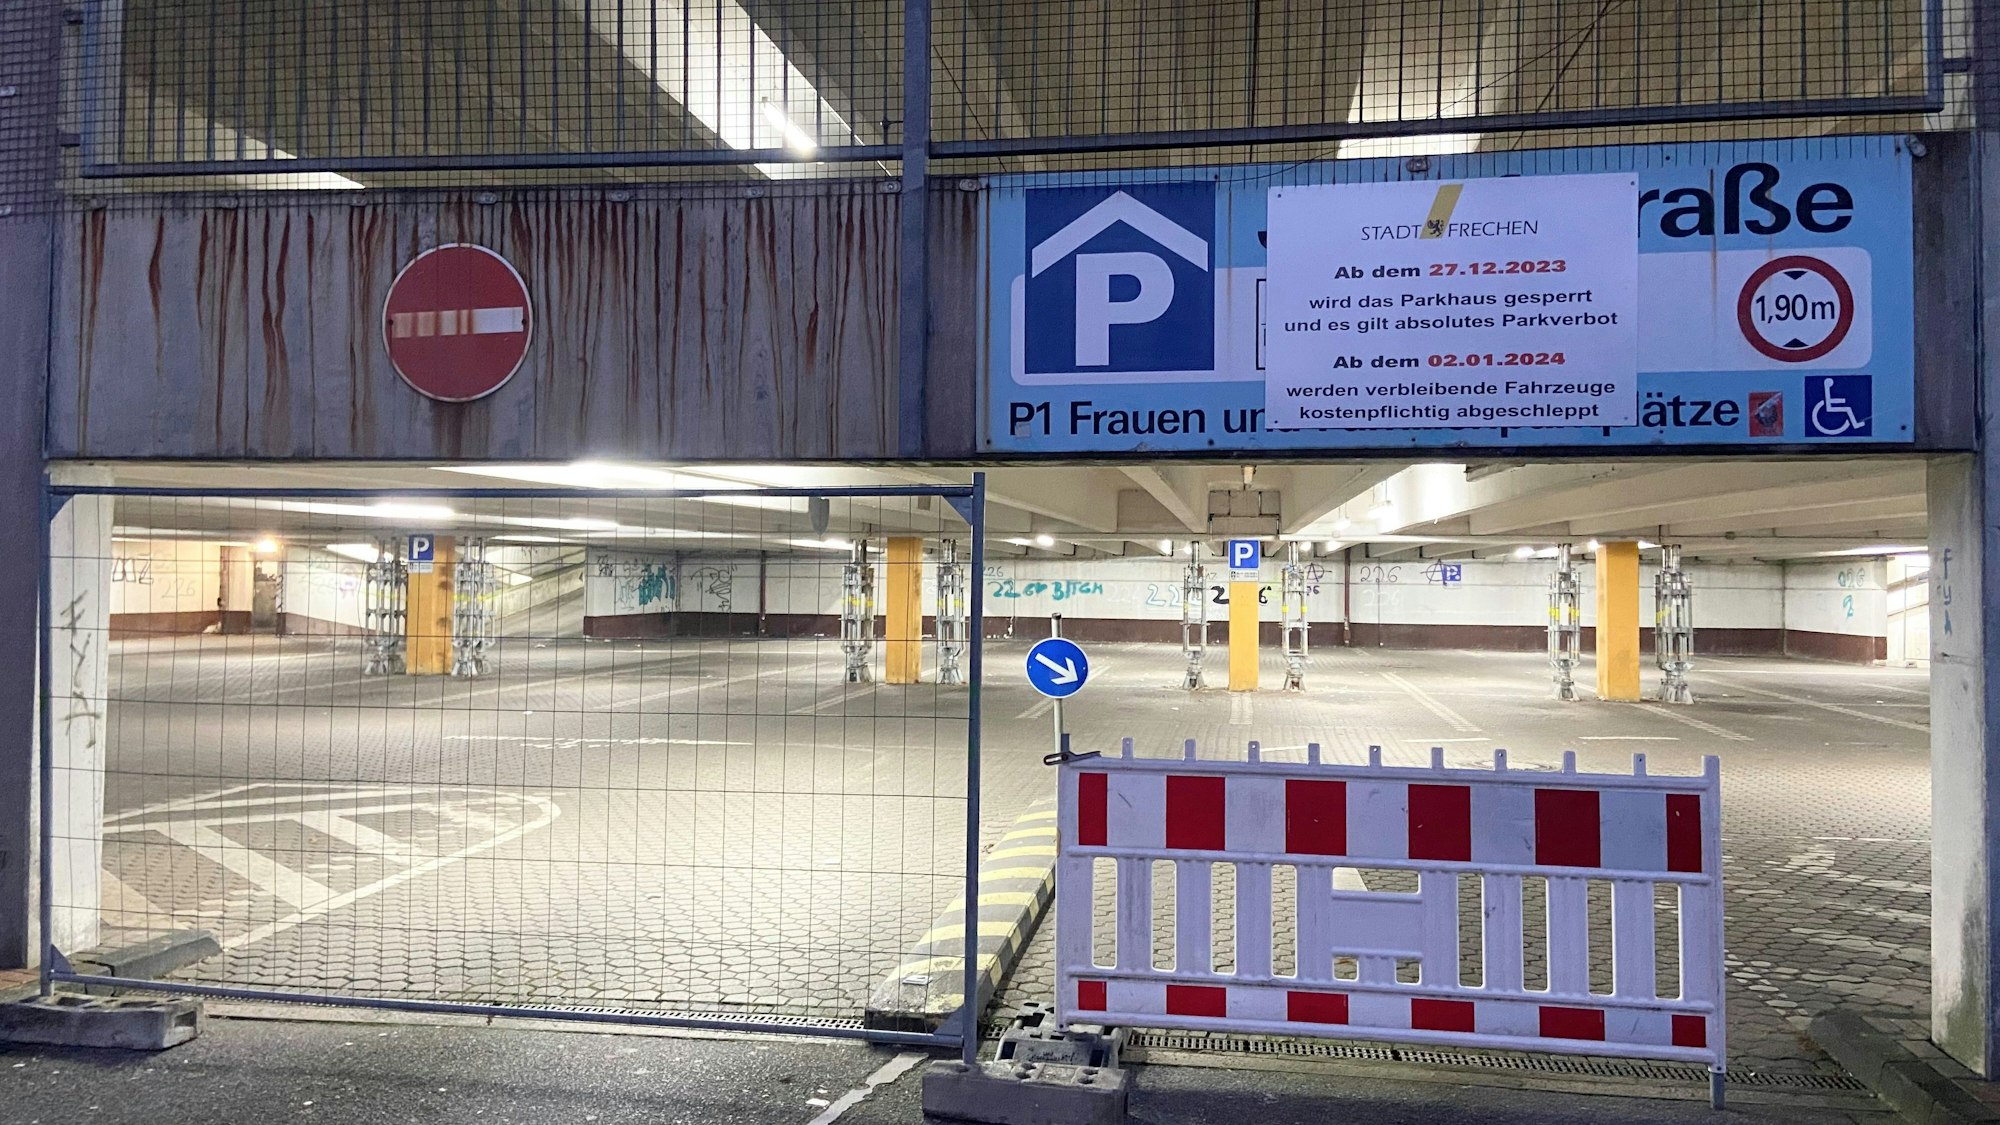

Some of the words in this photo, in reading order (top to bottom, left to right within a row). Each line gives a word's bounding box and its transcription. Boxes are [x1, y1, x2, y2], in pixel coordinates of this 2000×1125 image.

[1638, 162, 1854, 238] raße
[1361, 224, 1422, 241] STADT
[1448, 220, 1539, 238] FRECHEN
[1334, 266, 1364, 280] Ab
[1372, 264, 1421, 279] dem
[1429, 260, 1567, 277] 27.12.2023
[1075, 251, 1175, 367] P
[1309, 295, 1352, 310] wird
[1358, 294, 1394, 309] das
[1401, 292, 1497, 308] Parkhaus
[1503, 289, 1593, 308] gesperrt
[1284, 318, 1321, 332] und
[1328, 320, 1350, 332] es
[1357, 316, 1389, 334] gilt
[1395, 315, 1495, 330] absolutes
[1502, 311, 1618, 328] Parkverbot
[1333, 356, 1363, 369] Ab
[1370, 354, 1420, 369] dem
[1428, 352, 1566, 368] 02.01.2024
[1286, 383, 1359, 397] werden
[1365, 382, 1498, 396] verbleibende
[1505, 380, 1616, 397] Fahrzeuge
[1009, 402, 1051, 436] P1
[1070, 400, 1206, 435] Frauen
[1636, 392, 1740, 428] ätze
[1299, 404, 1450, 422] kostenpflichtig
[1456, 402, 1600, 422] abgeschleppt
[412, 537, 430, 560] P
[1235, 542, 1254, 567] P
[1360, 566, 1402, 582] 226
